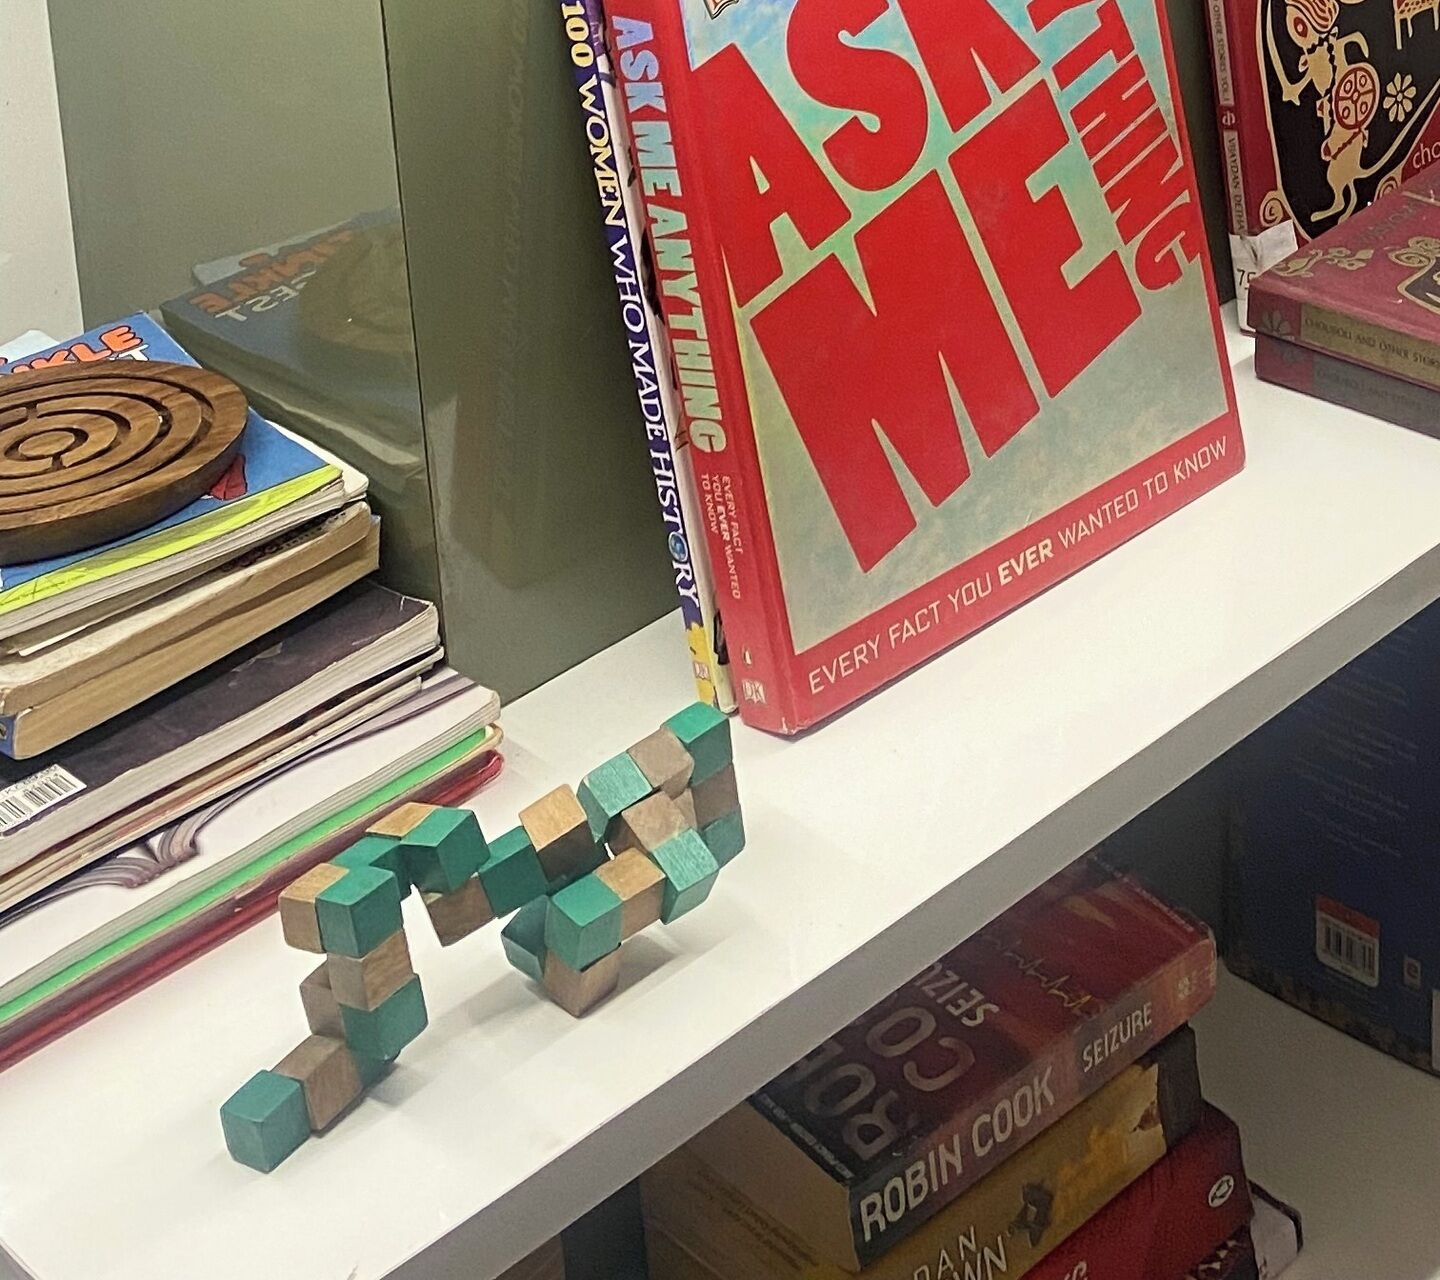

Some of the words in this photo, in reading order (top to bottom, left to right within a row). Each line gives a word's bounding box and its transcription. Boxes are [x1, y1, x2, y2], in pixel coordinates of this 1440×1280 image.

[560, 1, 595, 68] 100
[612, 15, 668, 114] ASK
[578, 73, 627, 228] WOMEN
[630, 120, 683, 198] ME
[1227, 134, 1240, 186] VIJAYDAN
[611, 233, 646, 333] WHO
[646, 203, 728, 454] ANYTHING
[750, 77, 1143, 574] ME
[1305, 315, 1354, 339] CHOUBOLI
[1355, 329, 1378, 348] AND
[627, 339, 670, 442] MADE
[701, 472, 711, 493] TO
[704, 495, 718, 535] KNOW
[711, 473, 723, 500] YOU
[715, 500, 729, 540] EVER
[721, 475, 737, 521] EVERY
[730, 522, 744, 555] FACT
[650, 442, 701, 611] HISTORY
[808, 635, 881, 695] EVERY
[889, 602, 941, 649] FACT
[947, 572, 993, 613] YOU
[997, 538, 1054, 586] EVER
[1057, 487, 1140, 549] WANTED
[1143, 473, 1169, 502] TO
[1173, 435, 1228, 484] KNOW
[722, 542, 742, 600] WANTED
[742, 679, 768, 704] DK
[859, 1133, 963, 1243] ROBIN
[971, 1065, 1056, 1158] COOK
[1080, 1002, 1154, 1074] SEIZURE
